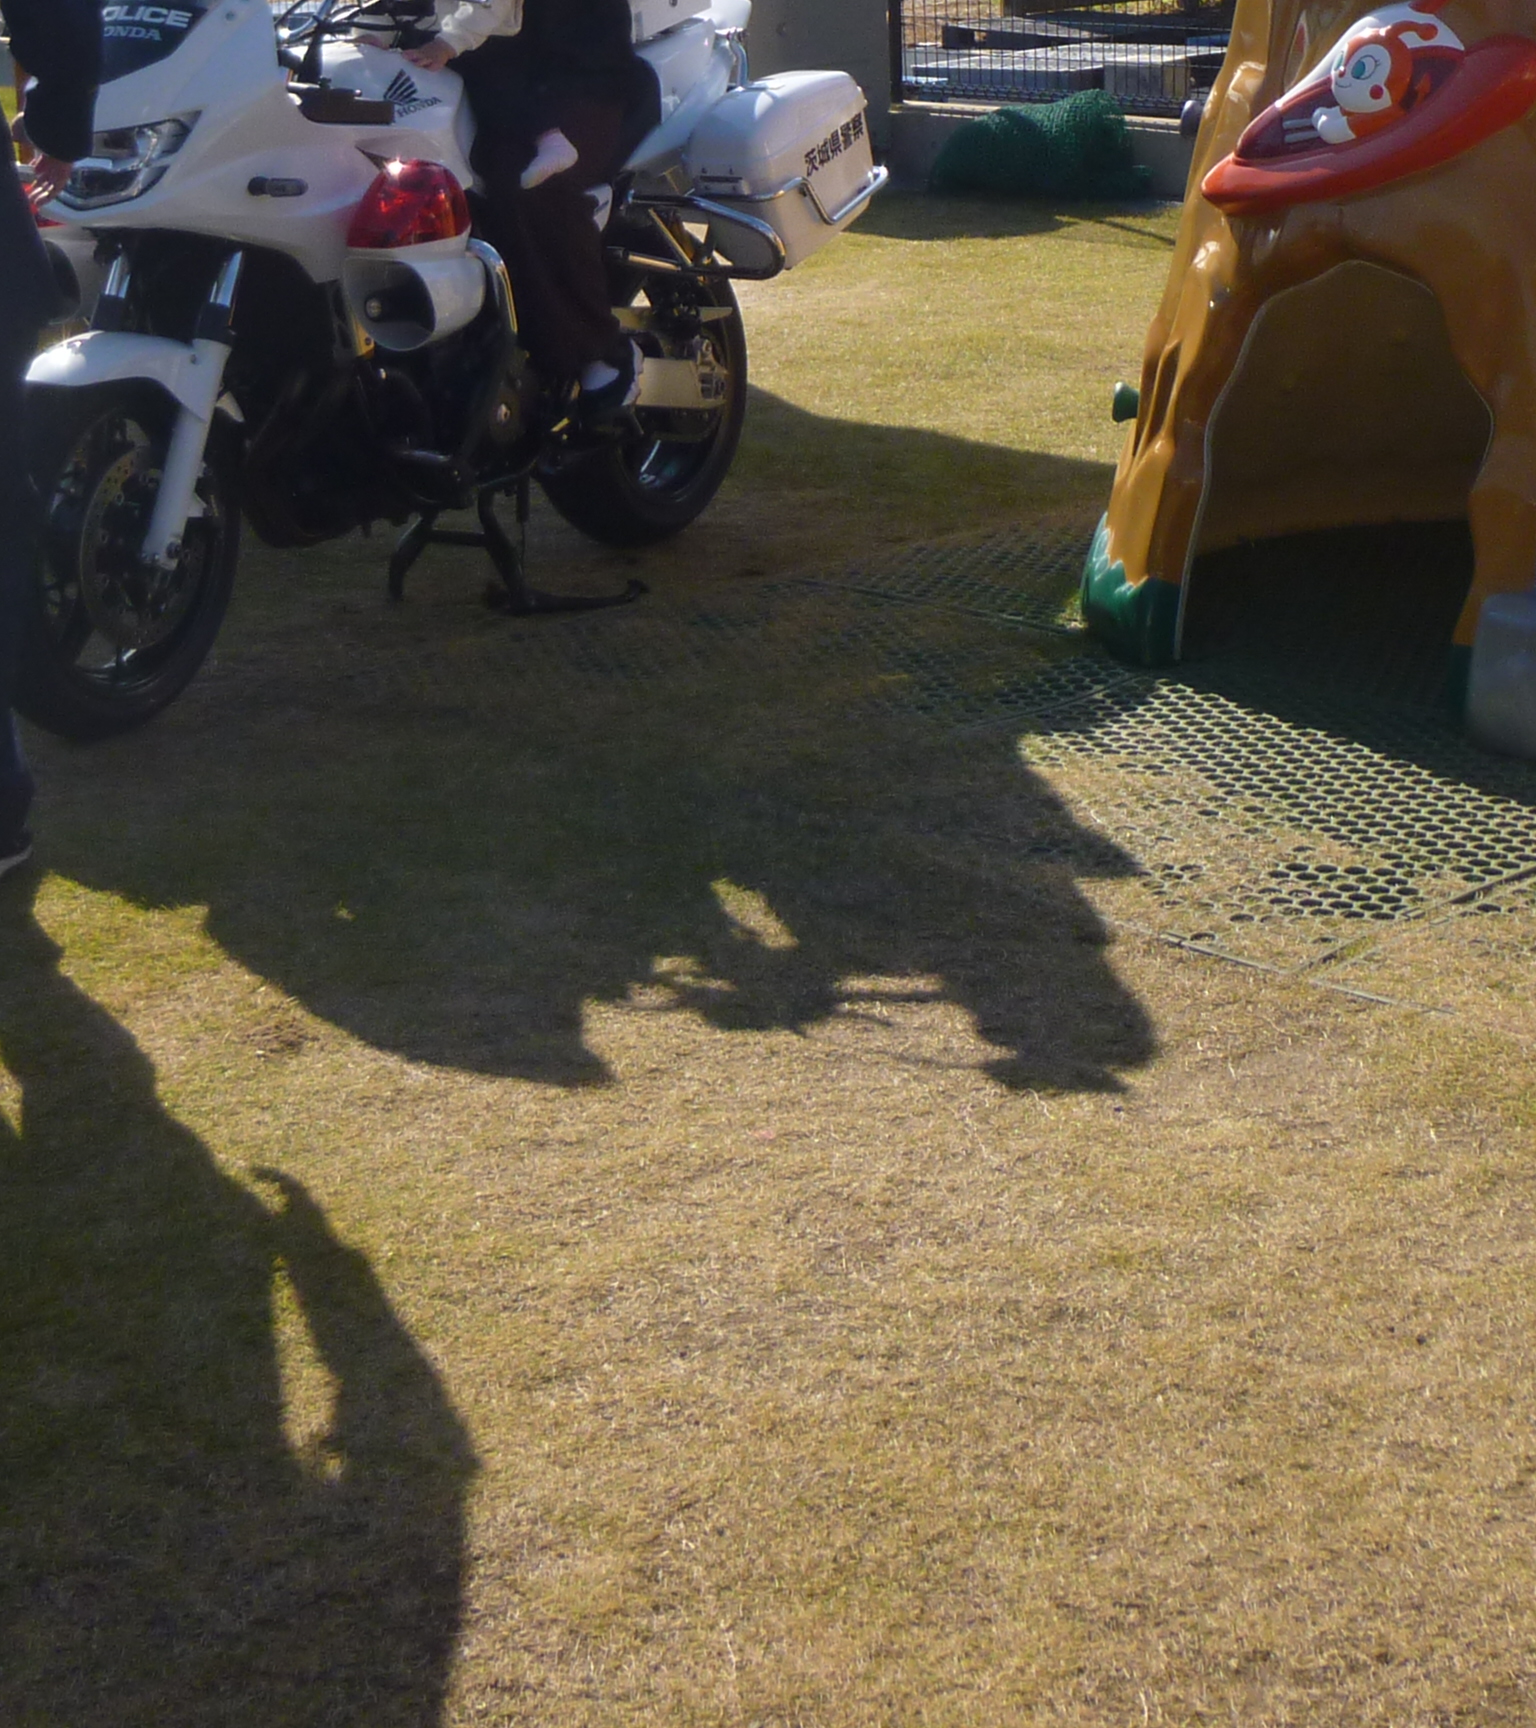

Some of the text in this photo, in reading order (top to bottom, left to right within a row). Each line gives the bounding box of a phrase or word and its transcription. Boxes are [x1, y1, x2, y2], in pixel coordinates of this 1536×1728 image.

[102, 5, 193, 28] OLICE
[103, 25, 162, 41] ONDA
[396, 96, 443, 118] HONDA
